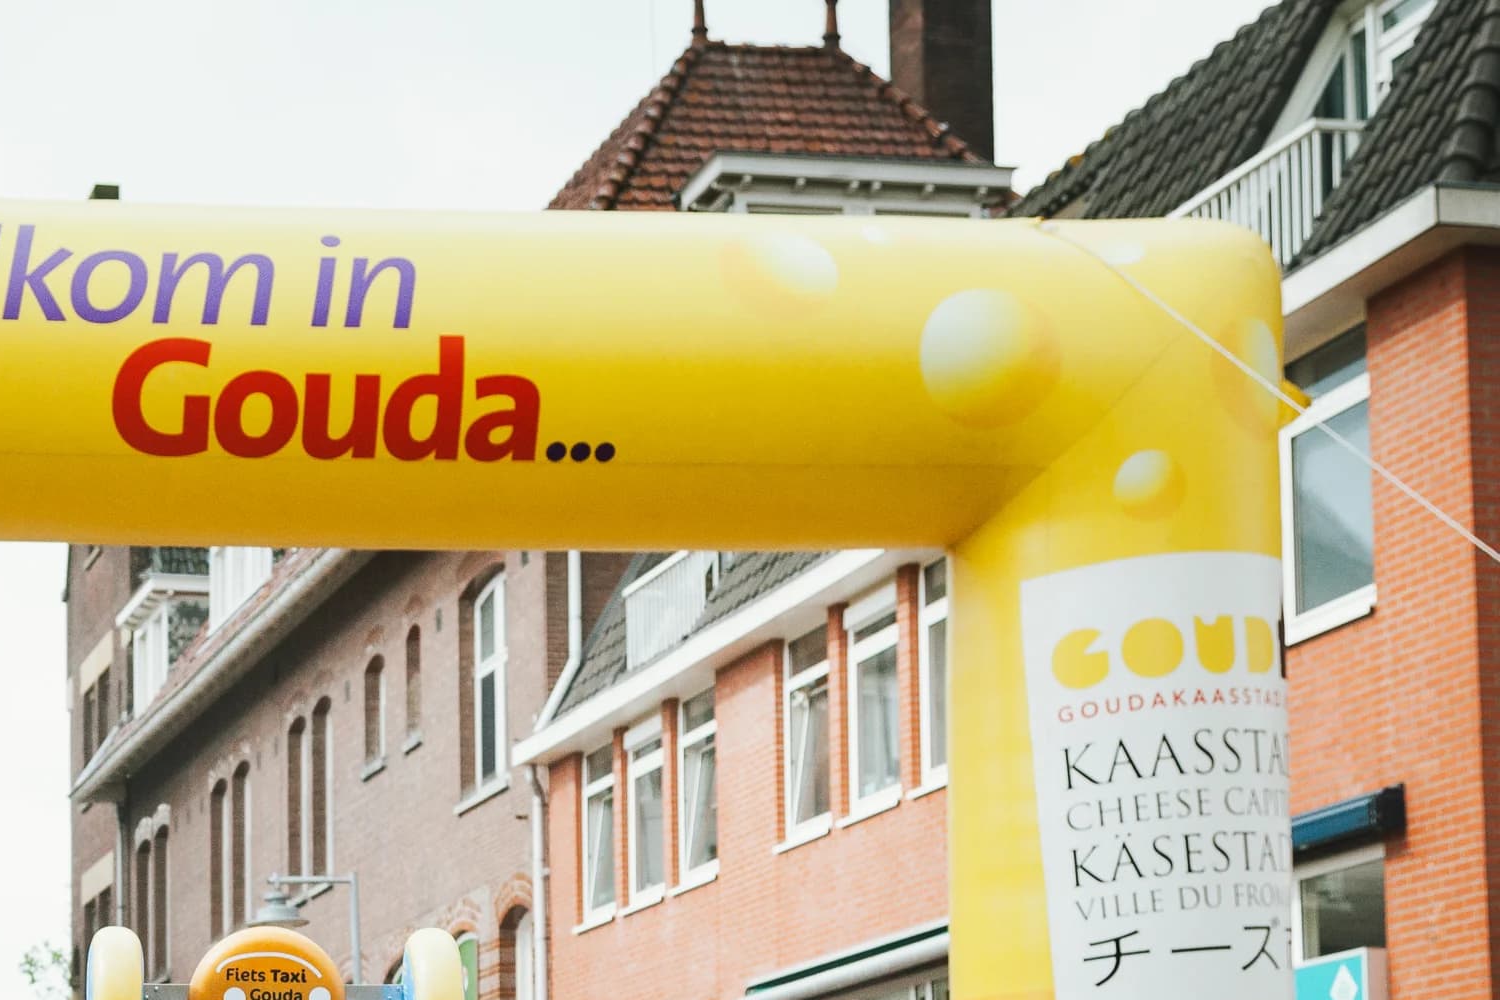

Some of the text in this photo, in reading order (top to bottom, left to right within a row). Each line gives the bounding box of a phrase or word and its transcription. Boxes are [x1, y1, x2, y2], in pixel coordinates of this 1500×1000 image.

[311, 234, 417, 329] in
[111, 335, 616, 463] Gouda...
[1067, 787, 1212, 832] CHEESE
[1075, 888, 1164, 920] VILLE
[1179, 884, 1222, 911] DU
[226, 968, 307, 983] Fiets Taxi
[1084, 916, 1292, 987] チーズ
